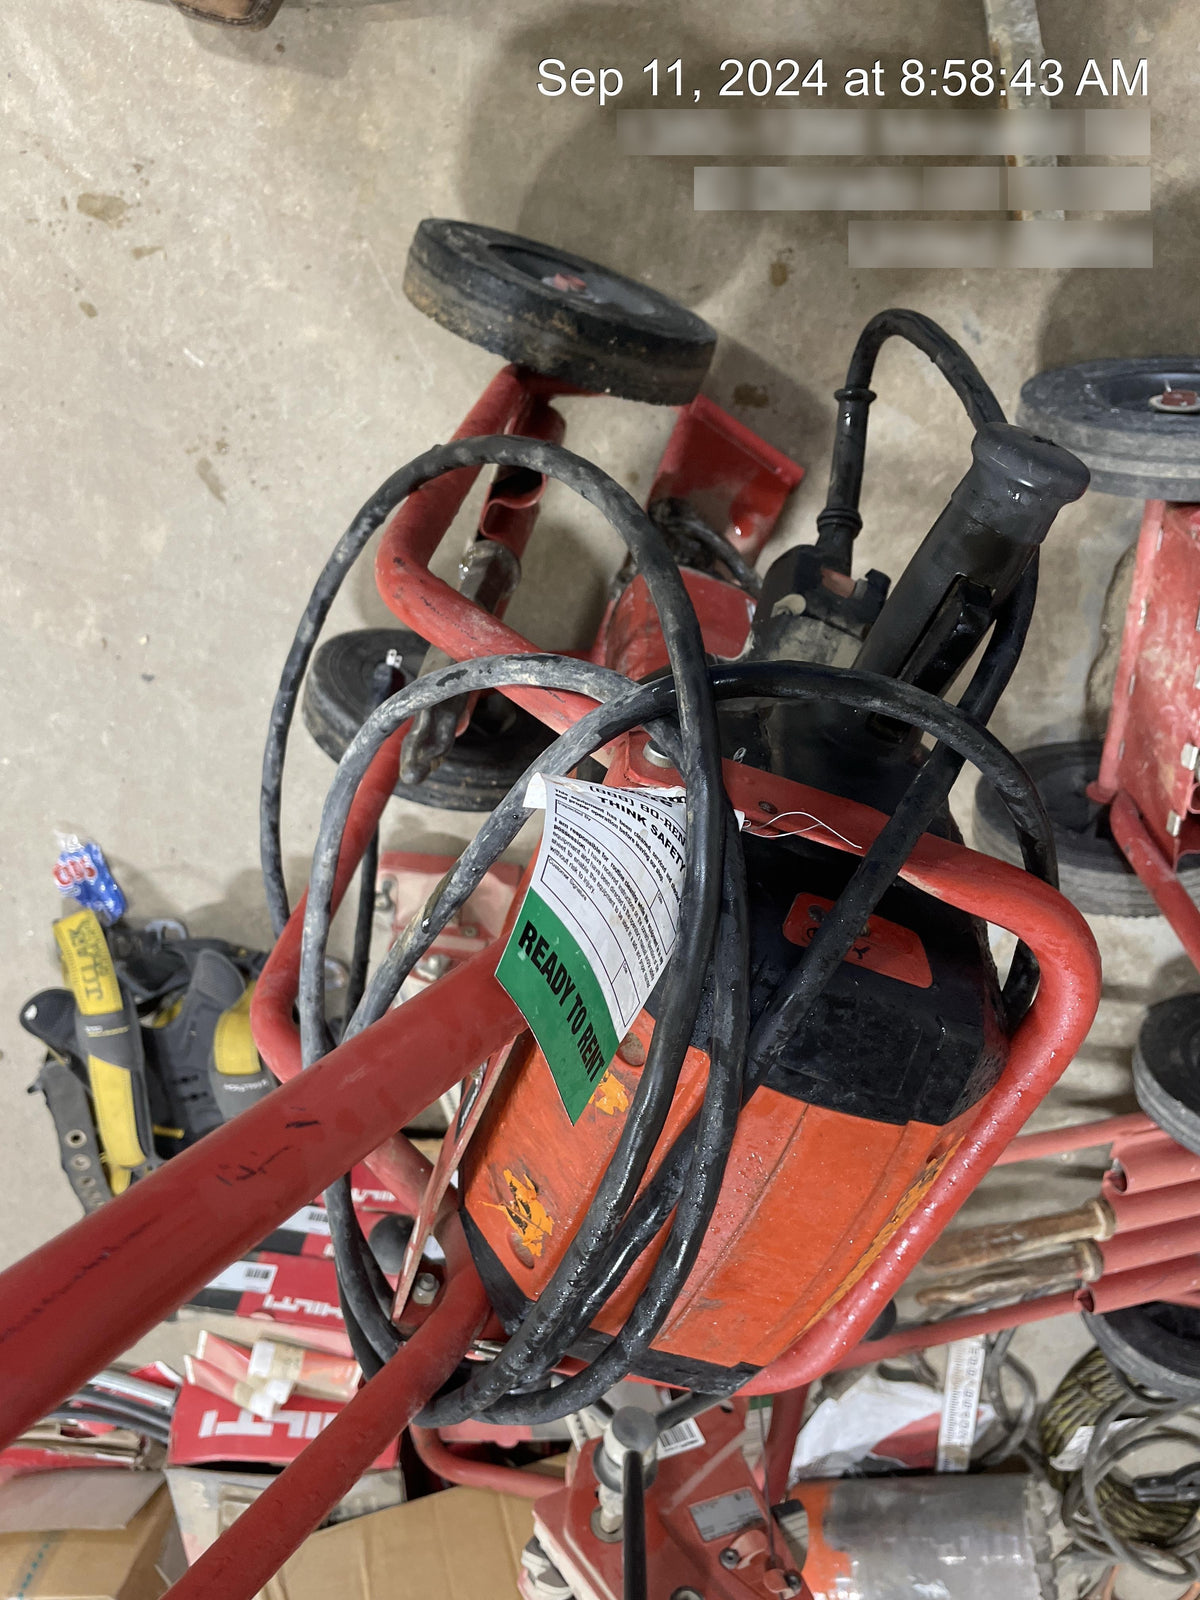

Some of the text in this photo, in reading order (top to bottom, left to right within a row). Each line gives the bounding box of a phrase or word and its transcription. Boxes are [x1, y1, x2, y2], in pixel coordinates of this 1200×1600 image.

[552, 831, 580, 855] equipment
[580, 852, 590, 864] and
[590, 860, 600, 875] have
[558, 820, 568, 828] am
[569, 827, 601, 854] responsible
[597, 796, 647, 827] THINK
[650, 823, 686, 872] SAFETY
[573, 856, 589, 874] enable
[590, 851, 601, 865] have
[518, 920, 605, 1083] READY TO RENT
